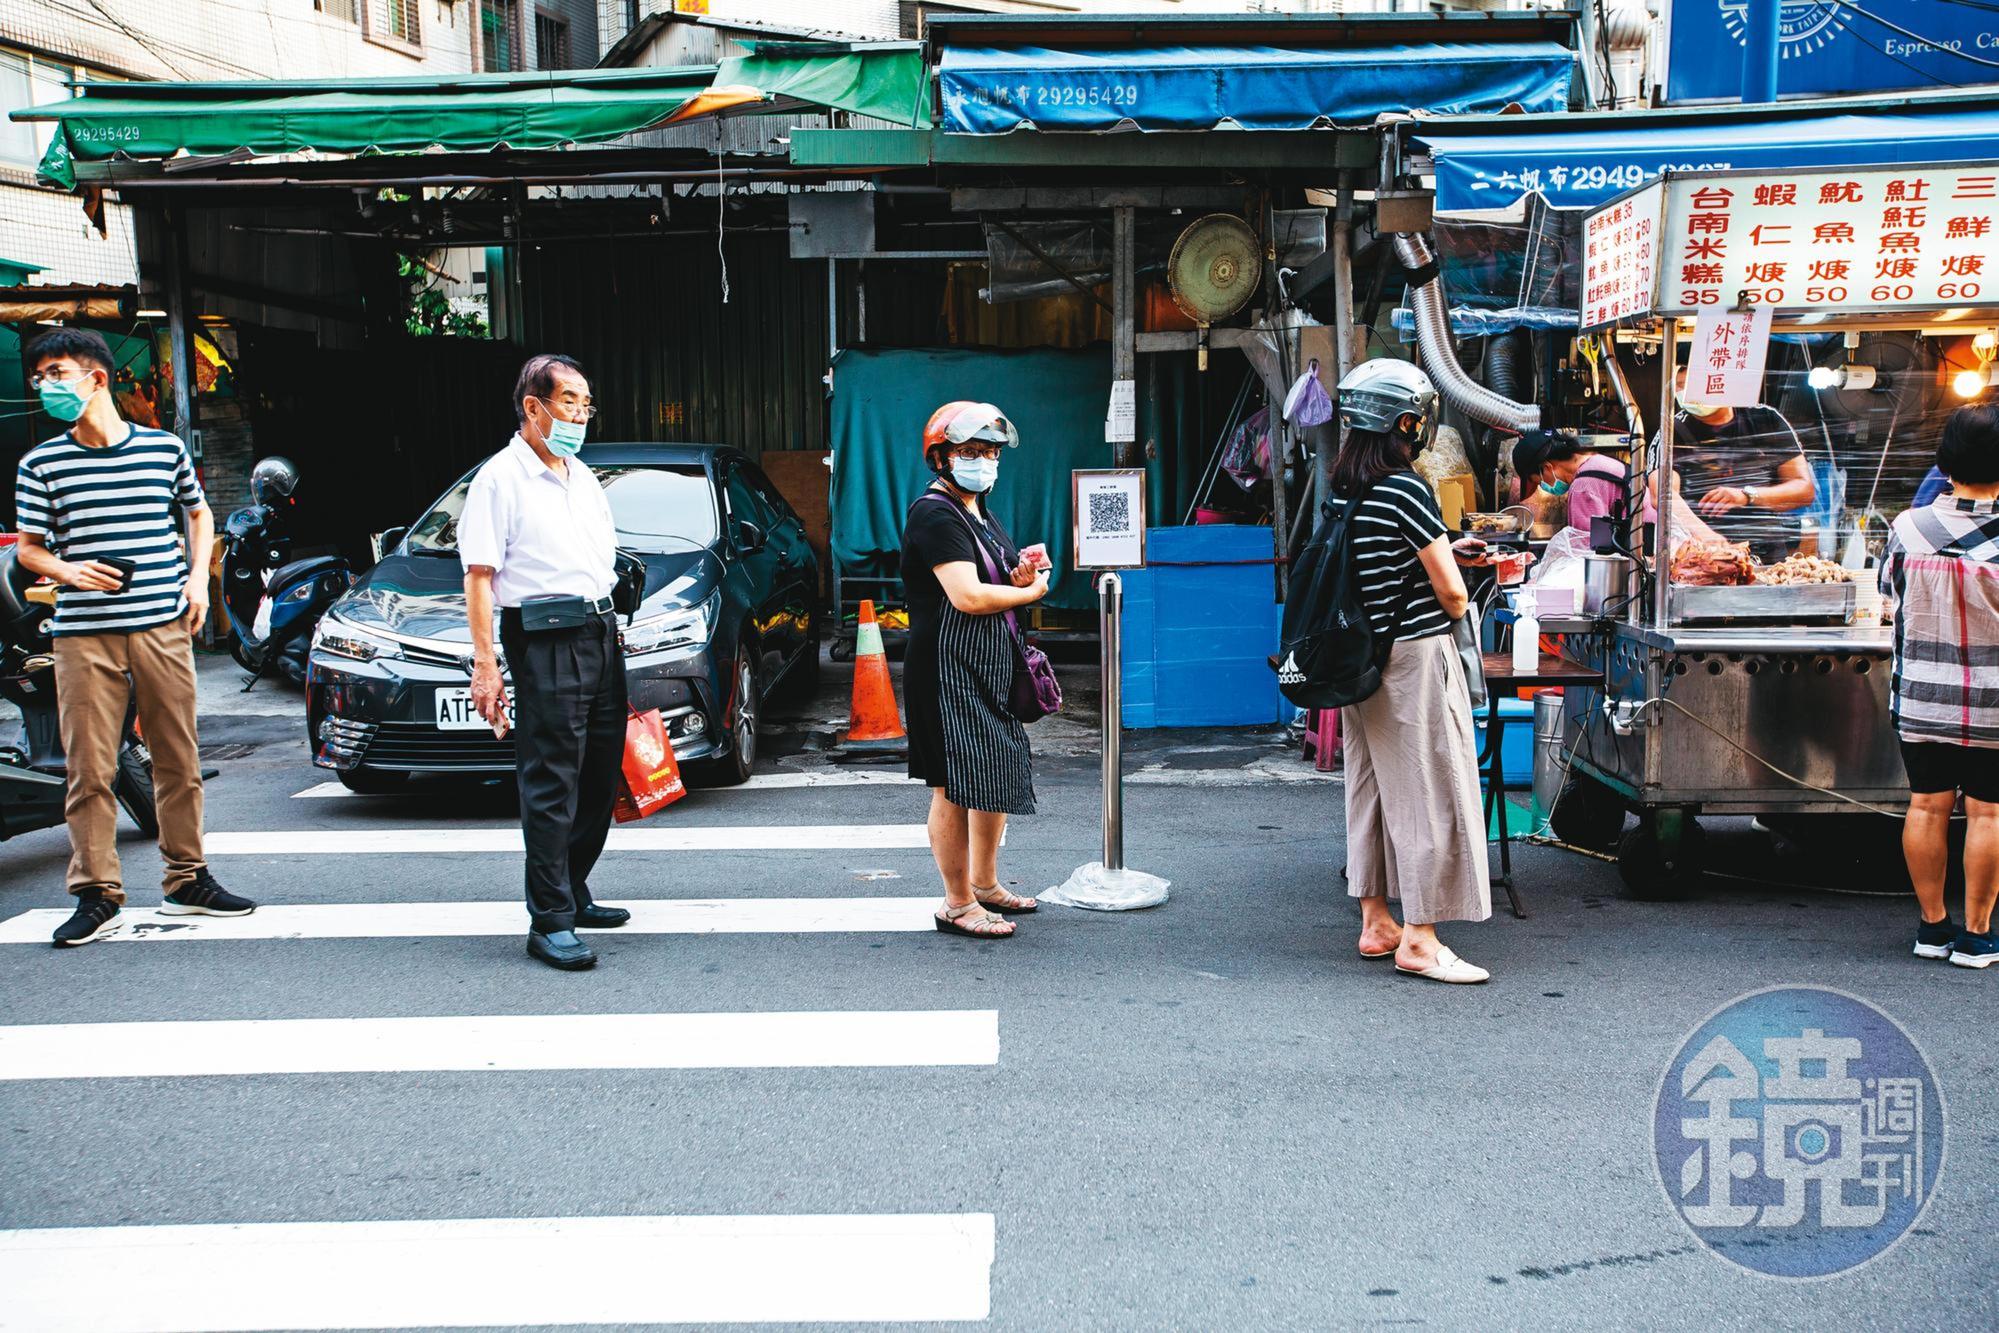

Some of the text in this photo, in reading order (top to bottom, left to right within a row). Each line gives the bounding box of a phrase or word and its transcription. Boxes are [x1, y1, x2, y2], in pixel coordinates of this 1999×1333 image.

[1037, 84, 1138, 106] 29295429
[74, 126, 140, 141] 29295429
[1470, 163, 1569, 192] 二六帆布
[1679, 186, 1735, 306] 台南米糕 35
[1744, 287, 1785, 304] 50
[1805, 286, 1848, 303] 50
[1870, 284, 1914, 301] 60
[1936, 282, 1981, 299] 60
[1706, 321, 1736, 395] 外帶區
